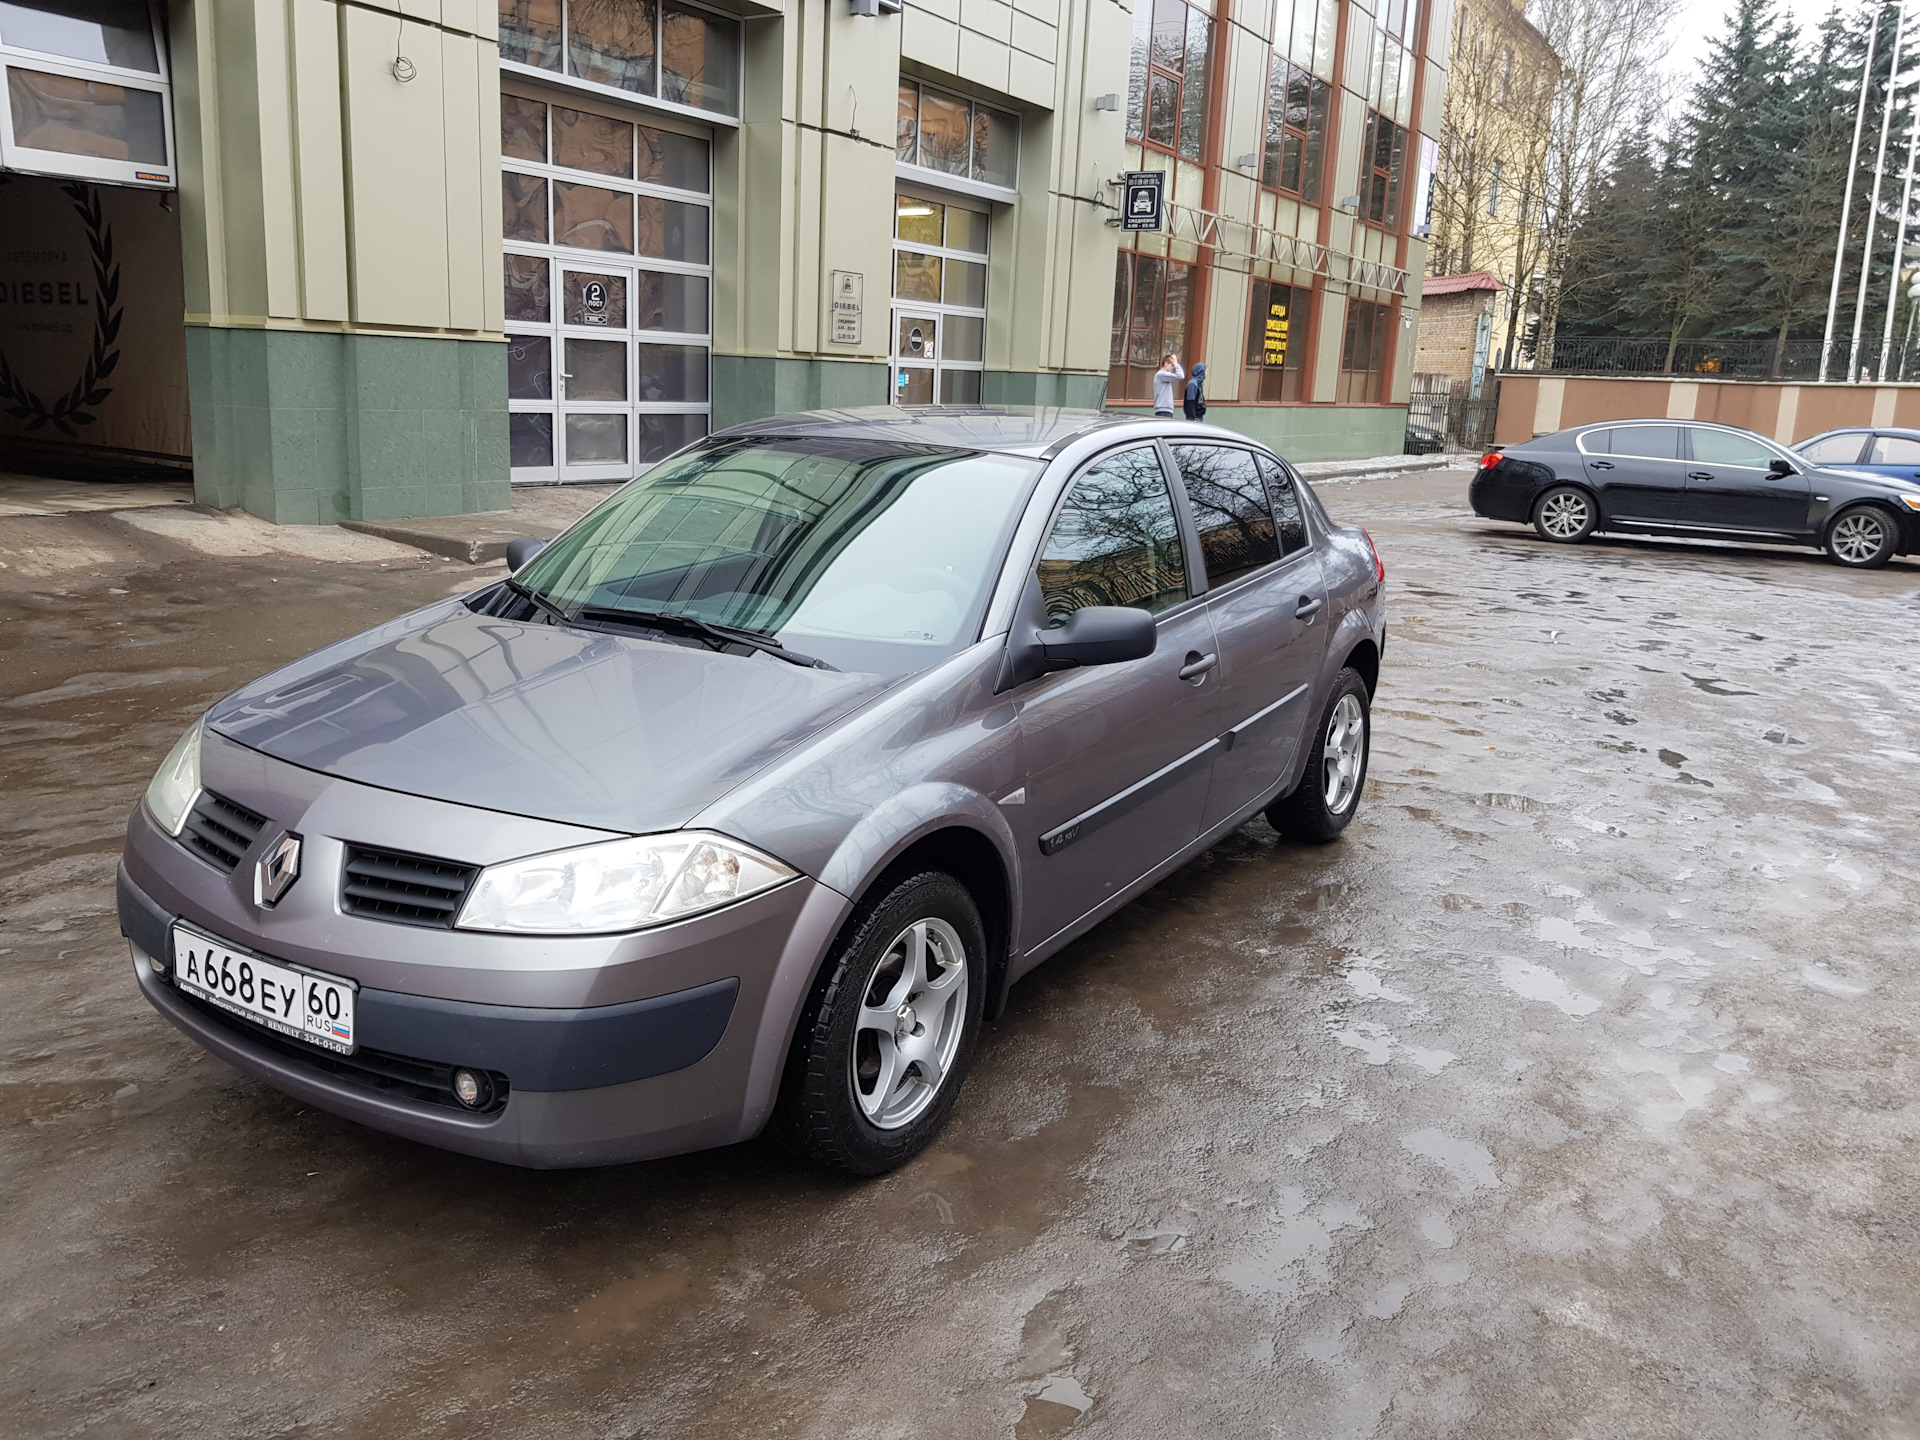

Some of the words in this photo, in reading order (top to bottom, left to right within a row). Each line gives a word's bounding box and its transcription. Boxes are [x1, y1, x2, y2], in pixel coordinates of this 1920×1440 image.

[0, 282, 88, 304] DIESEL
[591, 284, 600, 300] 2
[834, 302, 860, 311] DIESEL
[187, 949, 296, 1018] А668ЕУ
[308, 982, 340, 1020] 60
[307, 1015, 331, 1032] RUS
[267, 1020, 300, 1038] RENAULT
[304, 1033, 346, 1054] 334-01-01
